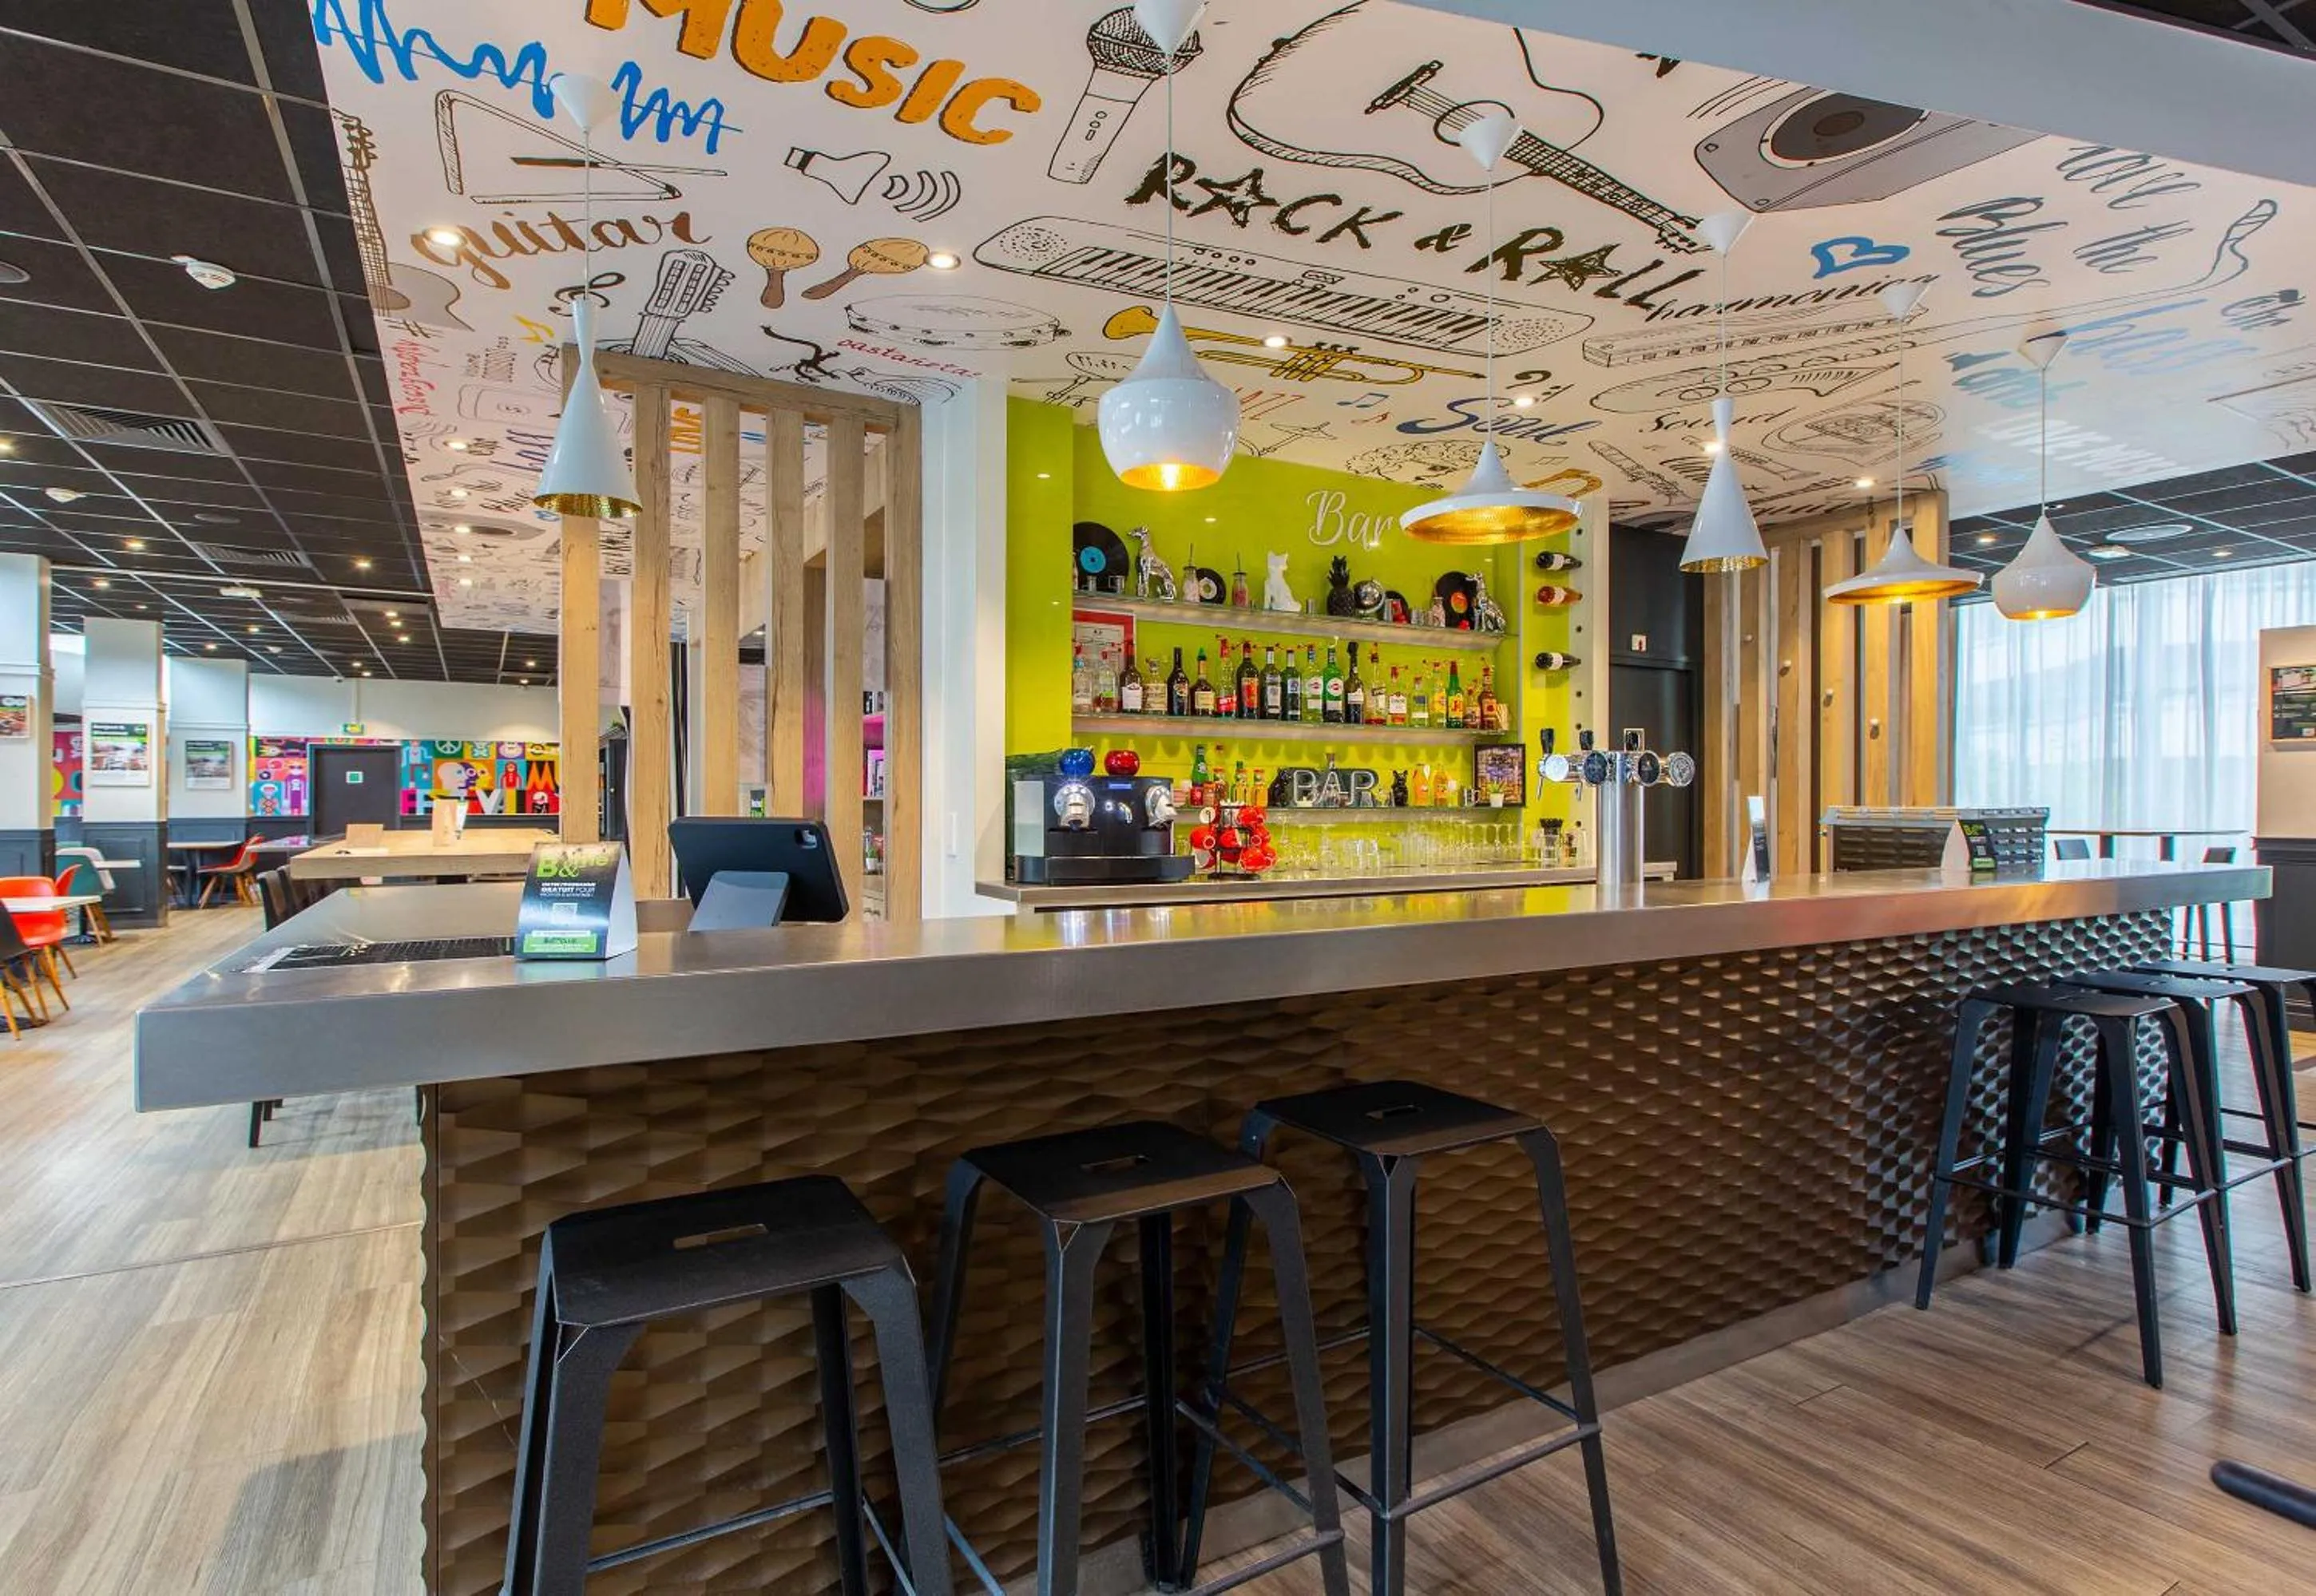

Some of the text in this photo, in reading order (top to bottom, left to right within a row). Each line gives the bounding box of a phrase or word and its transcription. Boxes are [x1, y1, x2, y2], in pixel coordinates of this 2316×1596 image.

[585, 0, 1041, 145] MUSIC
[1306, 489, 1394, 552] Bar
[1292, 769, 1375, 806] BAR
